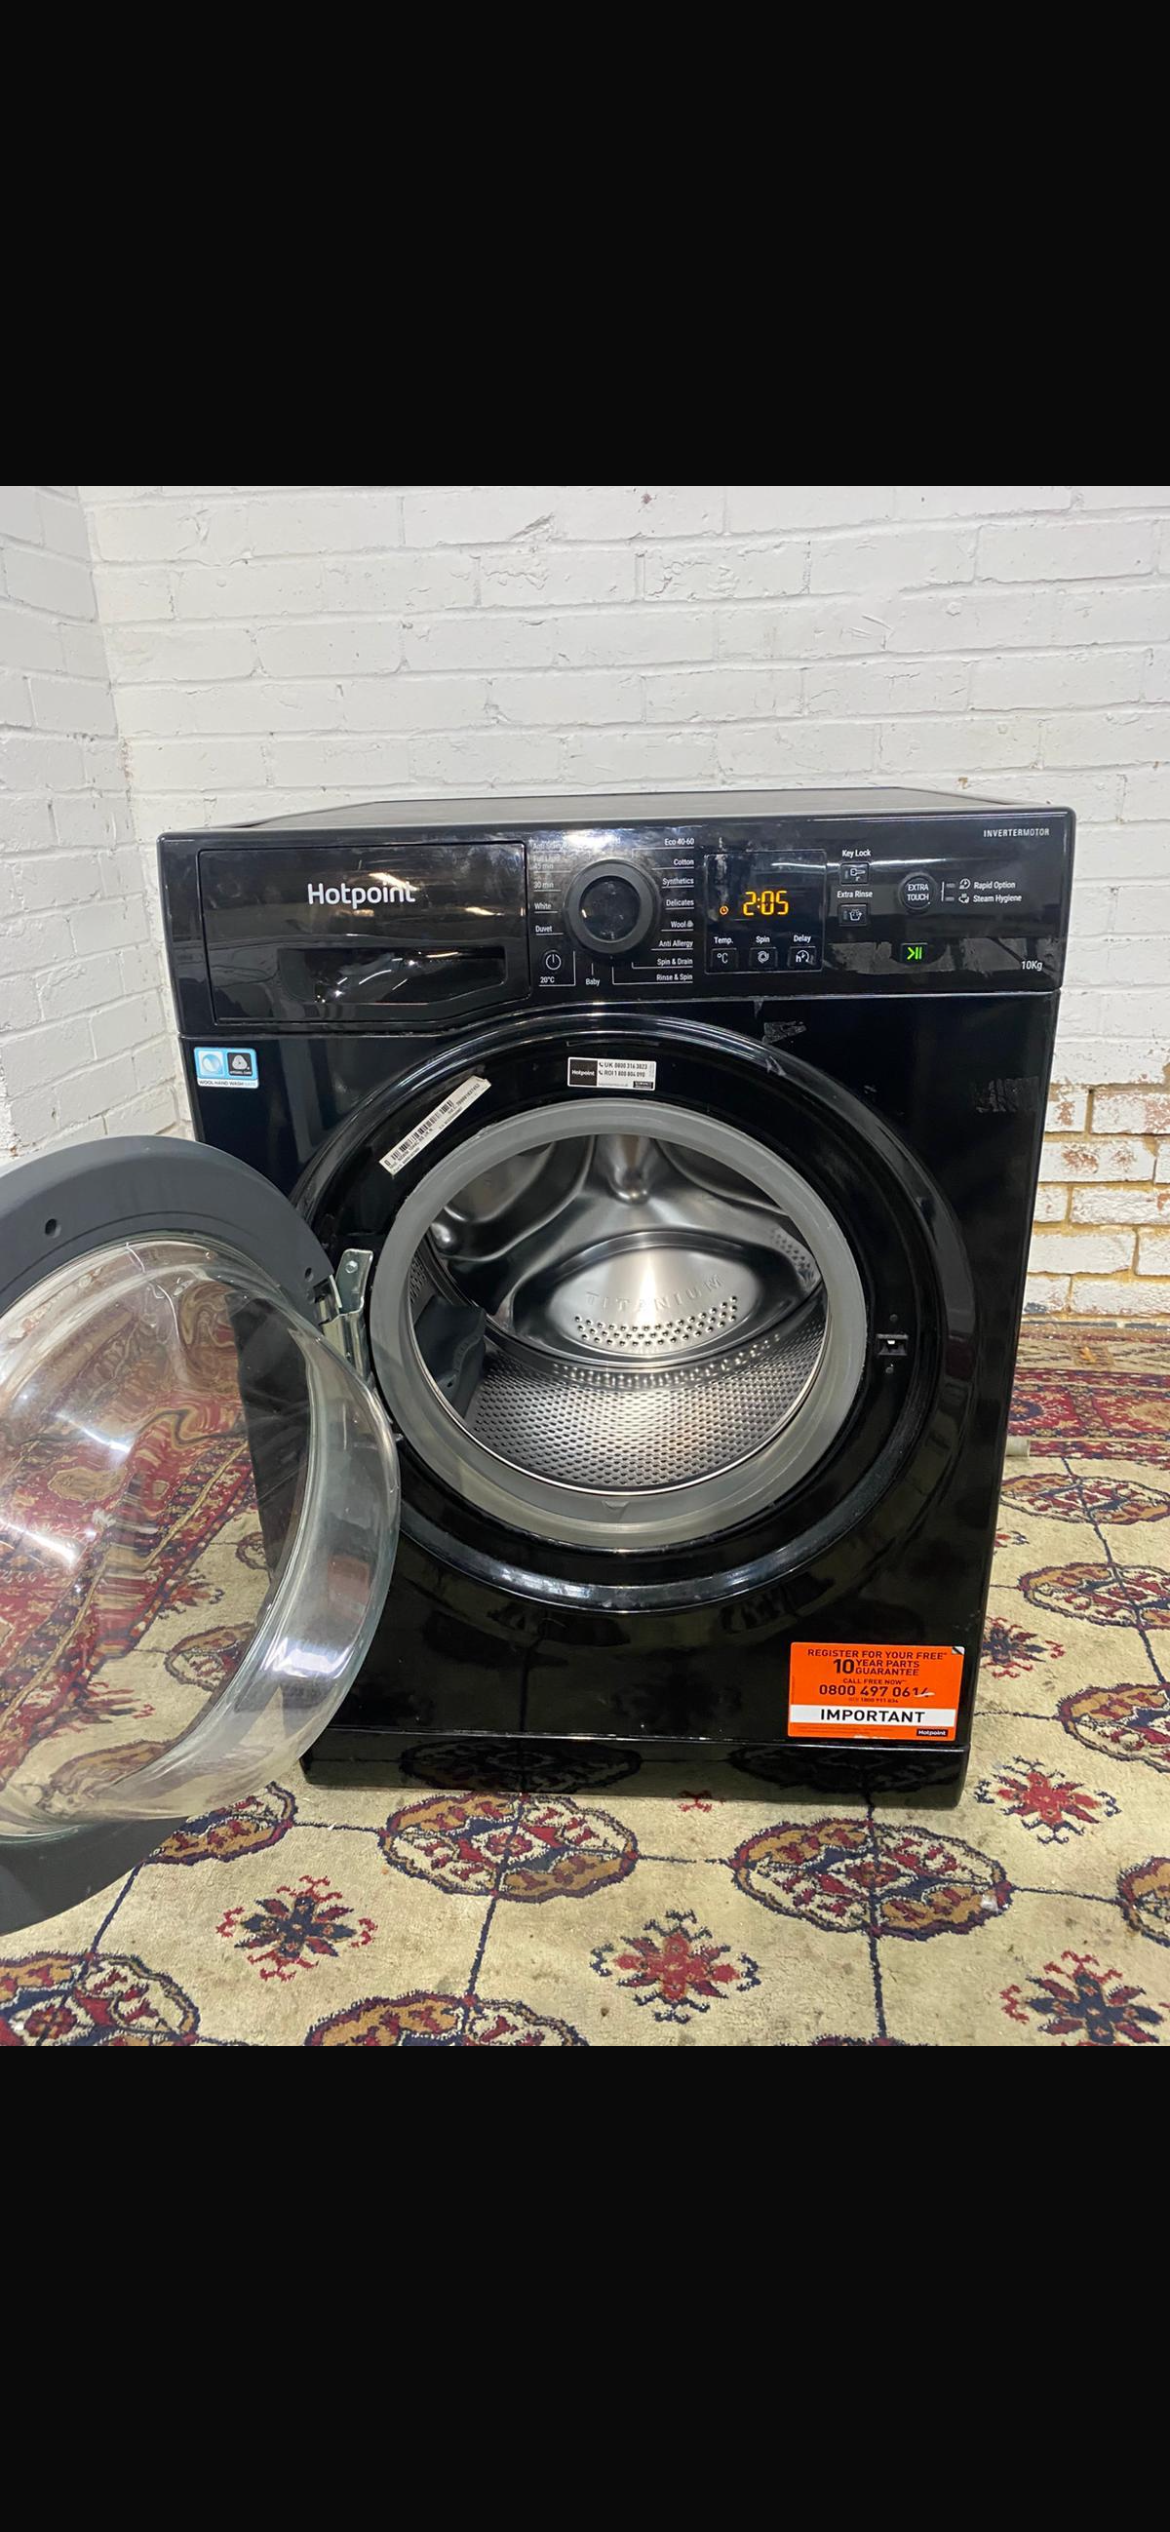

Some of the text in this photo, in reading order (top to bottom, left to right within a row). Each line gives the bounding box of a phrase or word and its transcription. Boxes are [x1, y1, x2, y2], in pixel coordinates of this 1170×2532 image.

[983, 828, 1050, 838] INVERTERMOTOR
[841, 848, 871, 859] Key Lock
[673, 858, 694, 866] Cotton
[662, 877, 694, 886] Synthetics
[973, 881, 1016, 891] Rapid Option
[907, 883, 929, 892] EXTRA
[307, 882, 416, 909] Hotpoint
[854, 890, 873, 898] Rinse
[907, 893, 929, 901] TOUCH
[973, 894, 1022, 903] Steam Hygiene
[534, 902, 552, 910] White
[742, 890, 789, 916] 2:05
[670, 920, 687, 928] Wool
[535, 925, 553, 933] Duvet
[672, 939, 694, 948] Allergy
[713, 936, 734, 944] Temp.
[755, 936, 771, 944] Spin
[793, 935, 812, 944] Delay
[1021, 961, 1043, 971] 10Kg
[540, 976, 555, 984] 20°C
[674, 973, 679, 981] &
[679, 973, 693, 981] Spin
[585, 978, 601, 986] Baby
[807, 1648, 859, 1658] REGISTER
[862, 1650, 882, 1659] FOR
[883, 1651, 913, 1660] YOUR
[833, 1658, 920, 1674] 10 YEAR PARTS
[855, 1667, 919, 1676] GUARANTEE
[819, 1684, 856, 1696] 0800
[860, 1686, 889, 1697] 497
[820, 1709, 925, 1723] IMPORTANT
